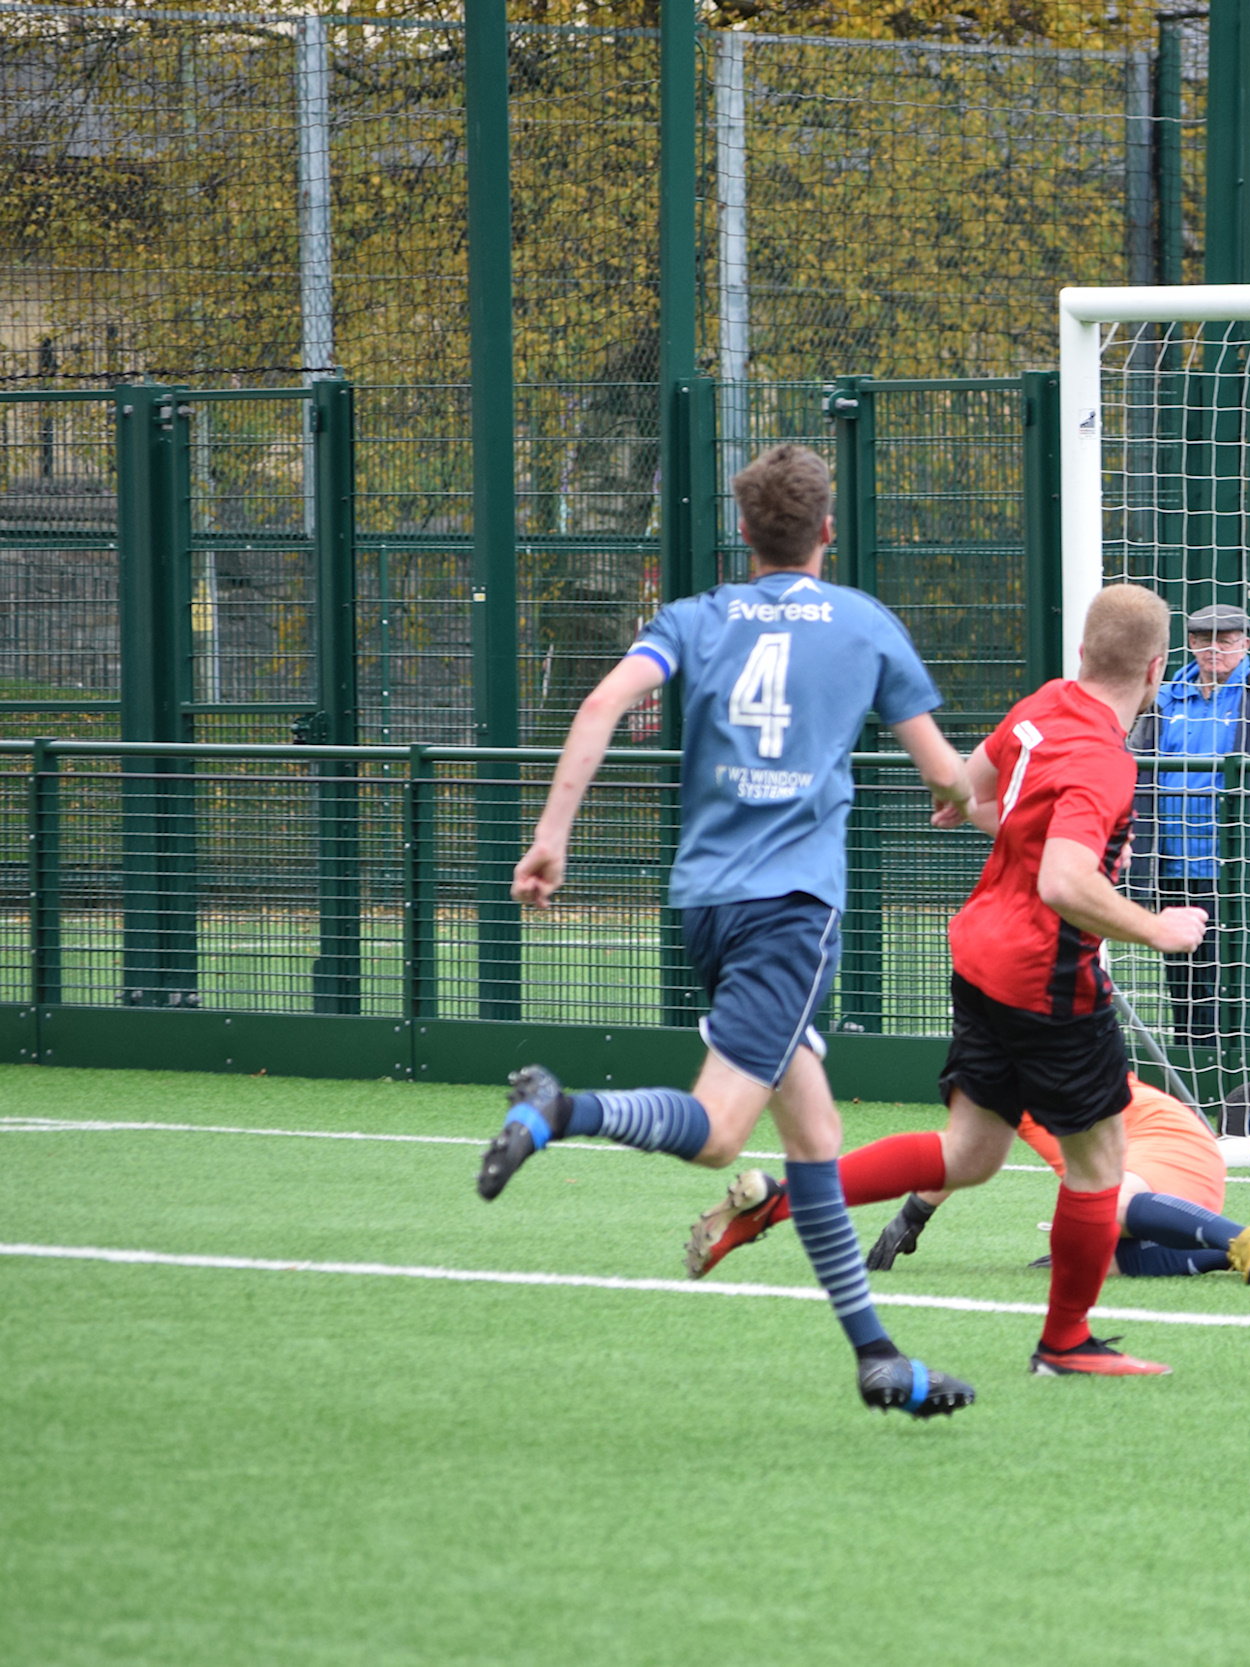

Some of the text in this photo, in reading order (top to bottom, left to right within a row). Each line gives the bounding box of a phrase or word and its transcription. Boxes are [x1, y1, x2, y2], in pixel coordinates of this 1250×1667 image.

[728, 599, 833, 623] Everest
[729, 632, 792, 758] 4
[727, 766, 815, 788] W2 WINDOW
